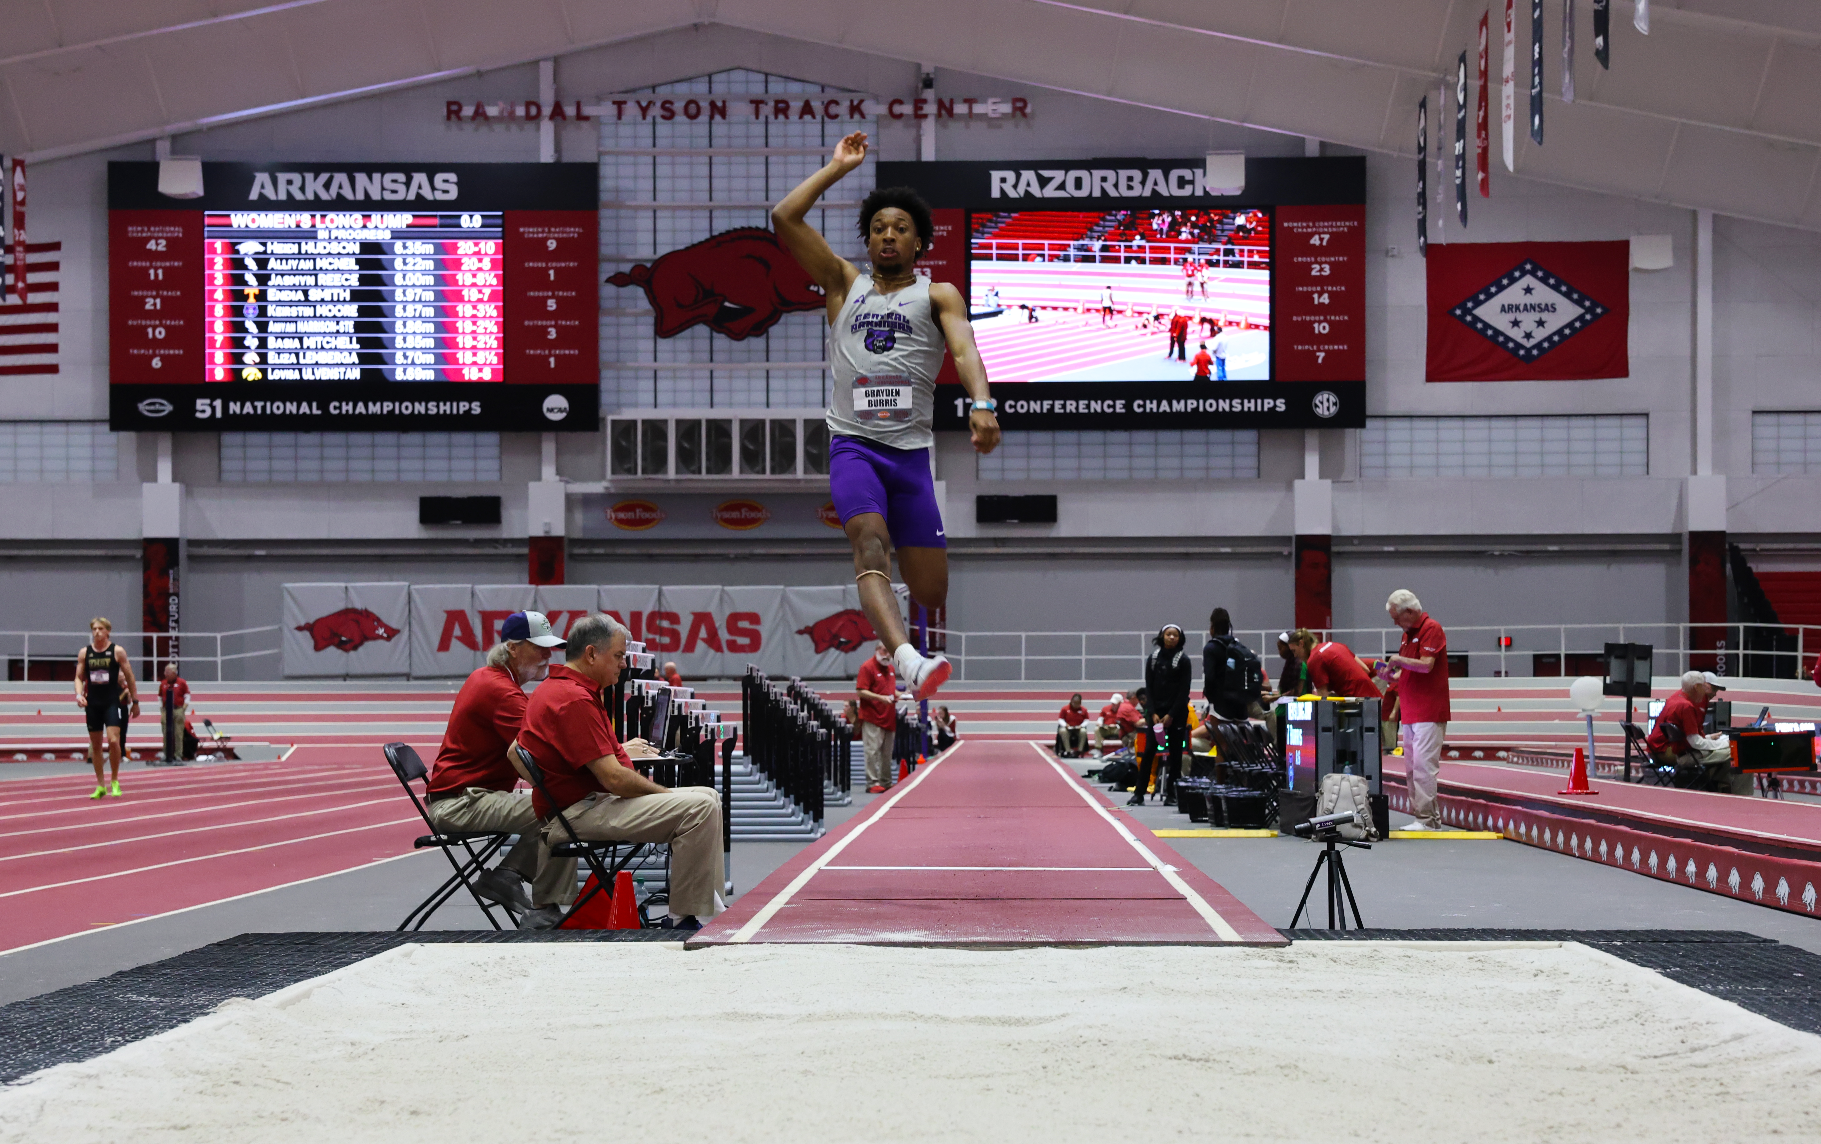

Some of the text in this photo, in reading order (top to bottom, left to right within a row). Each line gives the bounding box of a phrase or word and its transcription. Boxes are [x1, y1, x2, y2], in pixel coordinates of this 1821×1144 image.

[445, 98, 1029, 122] RANDAL TYSON TRACK CENTER
[249, 172, 458, 201] ARKANSAS
[989, 168, 1242, 199] RAZORBACK
[230, 213, 482, 229] WOMEN'S LONG JUMP 0.0
[317, 230, 392, 240] IN PROGRESS
[1309, 234, 1330, 247] 47
[146, 239, 167, 252] 42
[214, 241, 224, 254] 1
[301, 241, 360, 254] HUDSON
[457, 241, 496, 254] 20-10
[546, 239, 557, 251] 9
[214, 257, 224, 270] 2
[394, 257, 435, 270] 6.22m
[1310, 264, 1331, 276] 23
[148, 268, 163, 280] 11
[214, 272, 224, 286] 3
[317, 272, 360, 286] REECE
[394, 272, 435, 286] 6.00m
[548, 269, 555, 281] 1
[214, 288, 224, 302] 4
[308, 288, 351, 302] SMITH
[394, 288, 435, 302] 5.97m
[462, 288, 492, 302] 19-7
[1312, 293, 1330, 305] 14
[144, 297, 161, 310] 21
[546, 298, 557, 311] 5
[1500, 303, 1557, 314] ARKANSAS
[214, 304, 224, 317] 5
[315, 304, 359, 317] MOORE
[214, 319, 224, 333] 6
[1313, 322, 1330, 335] 10
[147, 327, 166, 339] 10
[547, 327, 557, 340] 3
[214, 335, 224, 349] 7
[303, 335, 361, 349] MITCHELL
[151, 356, 162, 369] 6
[214, 351, 224, 364] 8
[548, 356, 556, 369] 1
[1316, 352, 1326, 364] 7
[214, 367, 224, 380] 9
[864, 388, 901, 398] BRAYDEN
[195, 398, 481, 419] 51 NATIONAL CHAMPIONSHIPS
[867, 398, 898, 408] BURRIS
[1004, 399, 1126, 414] CONFERENCE
[1133, 398, 1286, 413] CHAMPIONSHIPS
[1314, 393, 1338, 416] SEC
